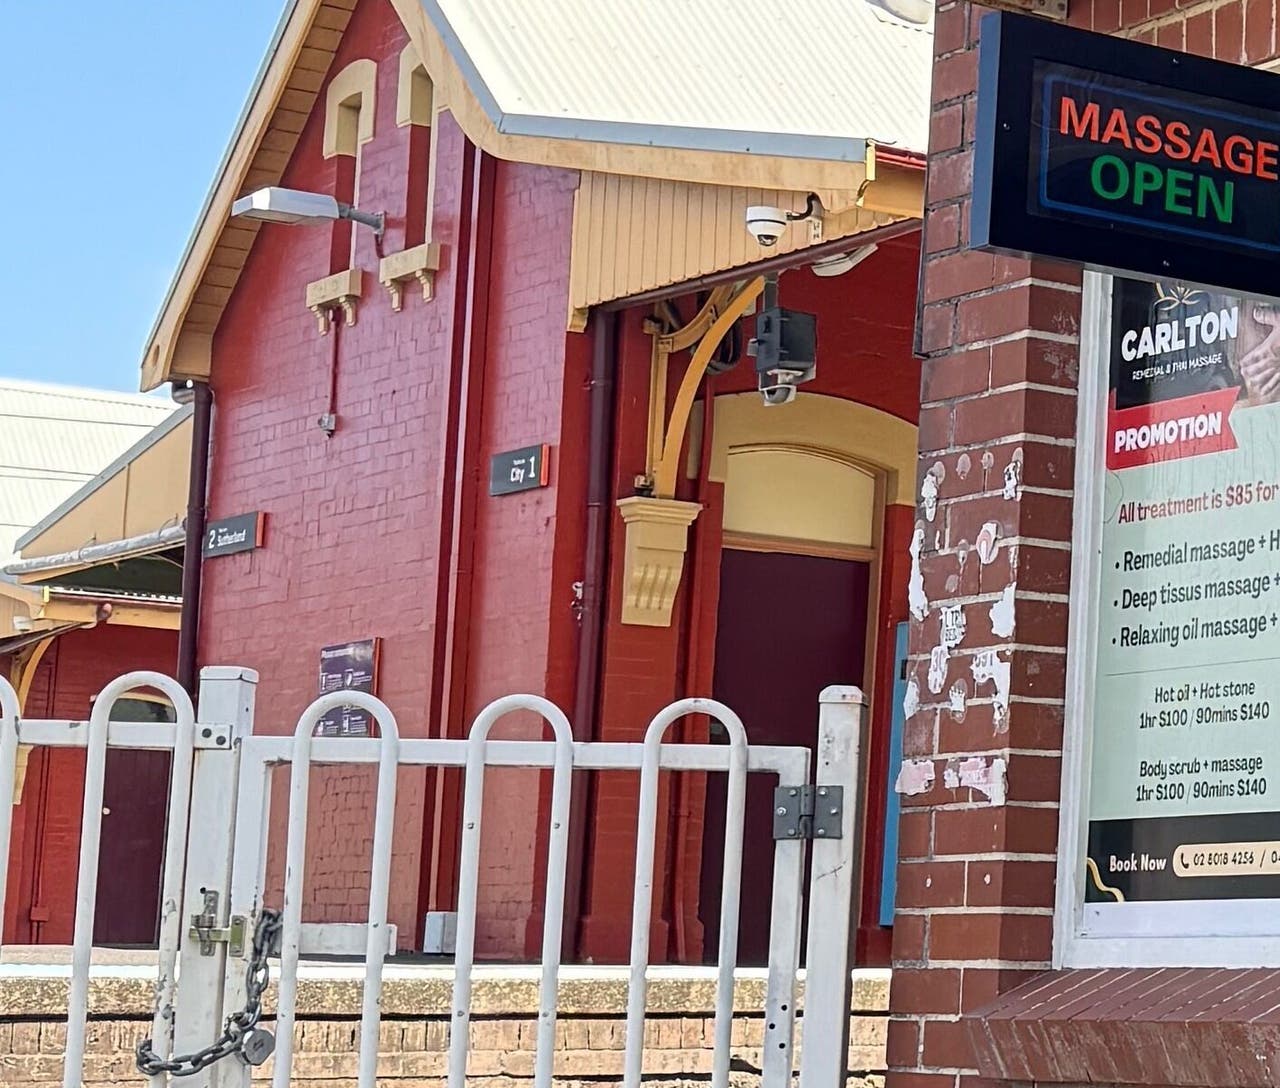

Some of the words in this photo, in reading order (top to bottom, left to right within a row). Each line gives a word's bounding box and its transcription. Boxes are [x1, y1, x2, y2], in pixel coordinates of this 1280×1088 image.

[1060, 97, 1279, 180] MASSAGE
[1090, 154, 1234, 224] OPEN
[1122, 307, 1238, 361] CARLTON
[1189, 353, 1222, 368] MASSAGE
[1115, 412, 1222, 453] PROMOTION
[510, 467, 525, 483] City
[528, 455, 536, 478] 1
[1118, 501, 1135, 523] All
[1138, 496, 1208, 521] treatment
[1211, 489, 1222, 509] is
[1225, 483, 1252, 508] $85
[1255, 481, 1279, 501] for
[209, 529, 216, 549] 2
[1123, 542, 1187, 572] Remedial
[1191, 536, 1255, 562] massage
[1258, 535, 1266, 549] +
[1121, 588, 1157, 611] Deep
[1160, 582, 1201, 604] tissus
[1204, 574, 1270, 599] massage
[1274, 573, 1280, 586] +
[1120, 621, 1179, 648] Relaxing
[1182, 618, 1198, 640] oil
[1201, 613, 1267, 639] massage
[1270, 612, 1278, 626] +
[1155, 687, 1175, 703] Hot
[1177, 684, 1189, 702] oil
[1192, 687, 1197, 697] +
[1200, 682, 1221, 700] Hot
[1222, 681, 1255, 698] stone
[1139, 712, 1157, 729] 1hr
[1196, 705, 1238, 724] 90mins
[1140, 760, 1167, 780] Body
[1168, 757, 1200, 775] scrub
[1203, 760, 1208, 769] +
[1211, 756, 1263, 775] massage
[1136, 784, 1154, 801] 1hr
[1193, 780, 1235, 798] 90mins
[1109, 854, 1138, 873] Book
[1141, 854, 1166, 872] Now
[1193, 853, 1205, 866] 02
